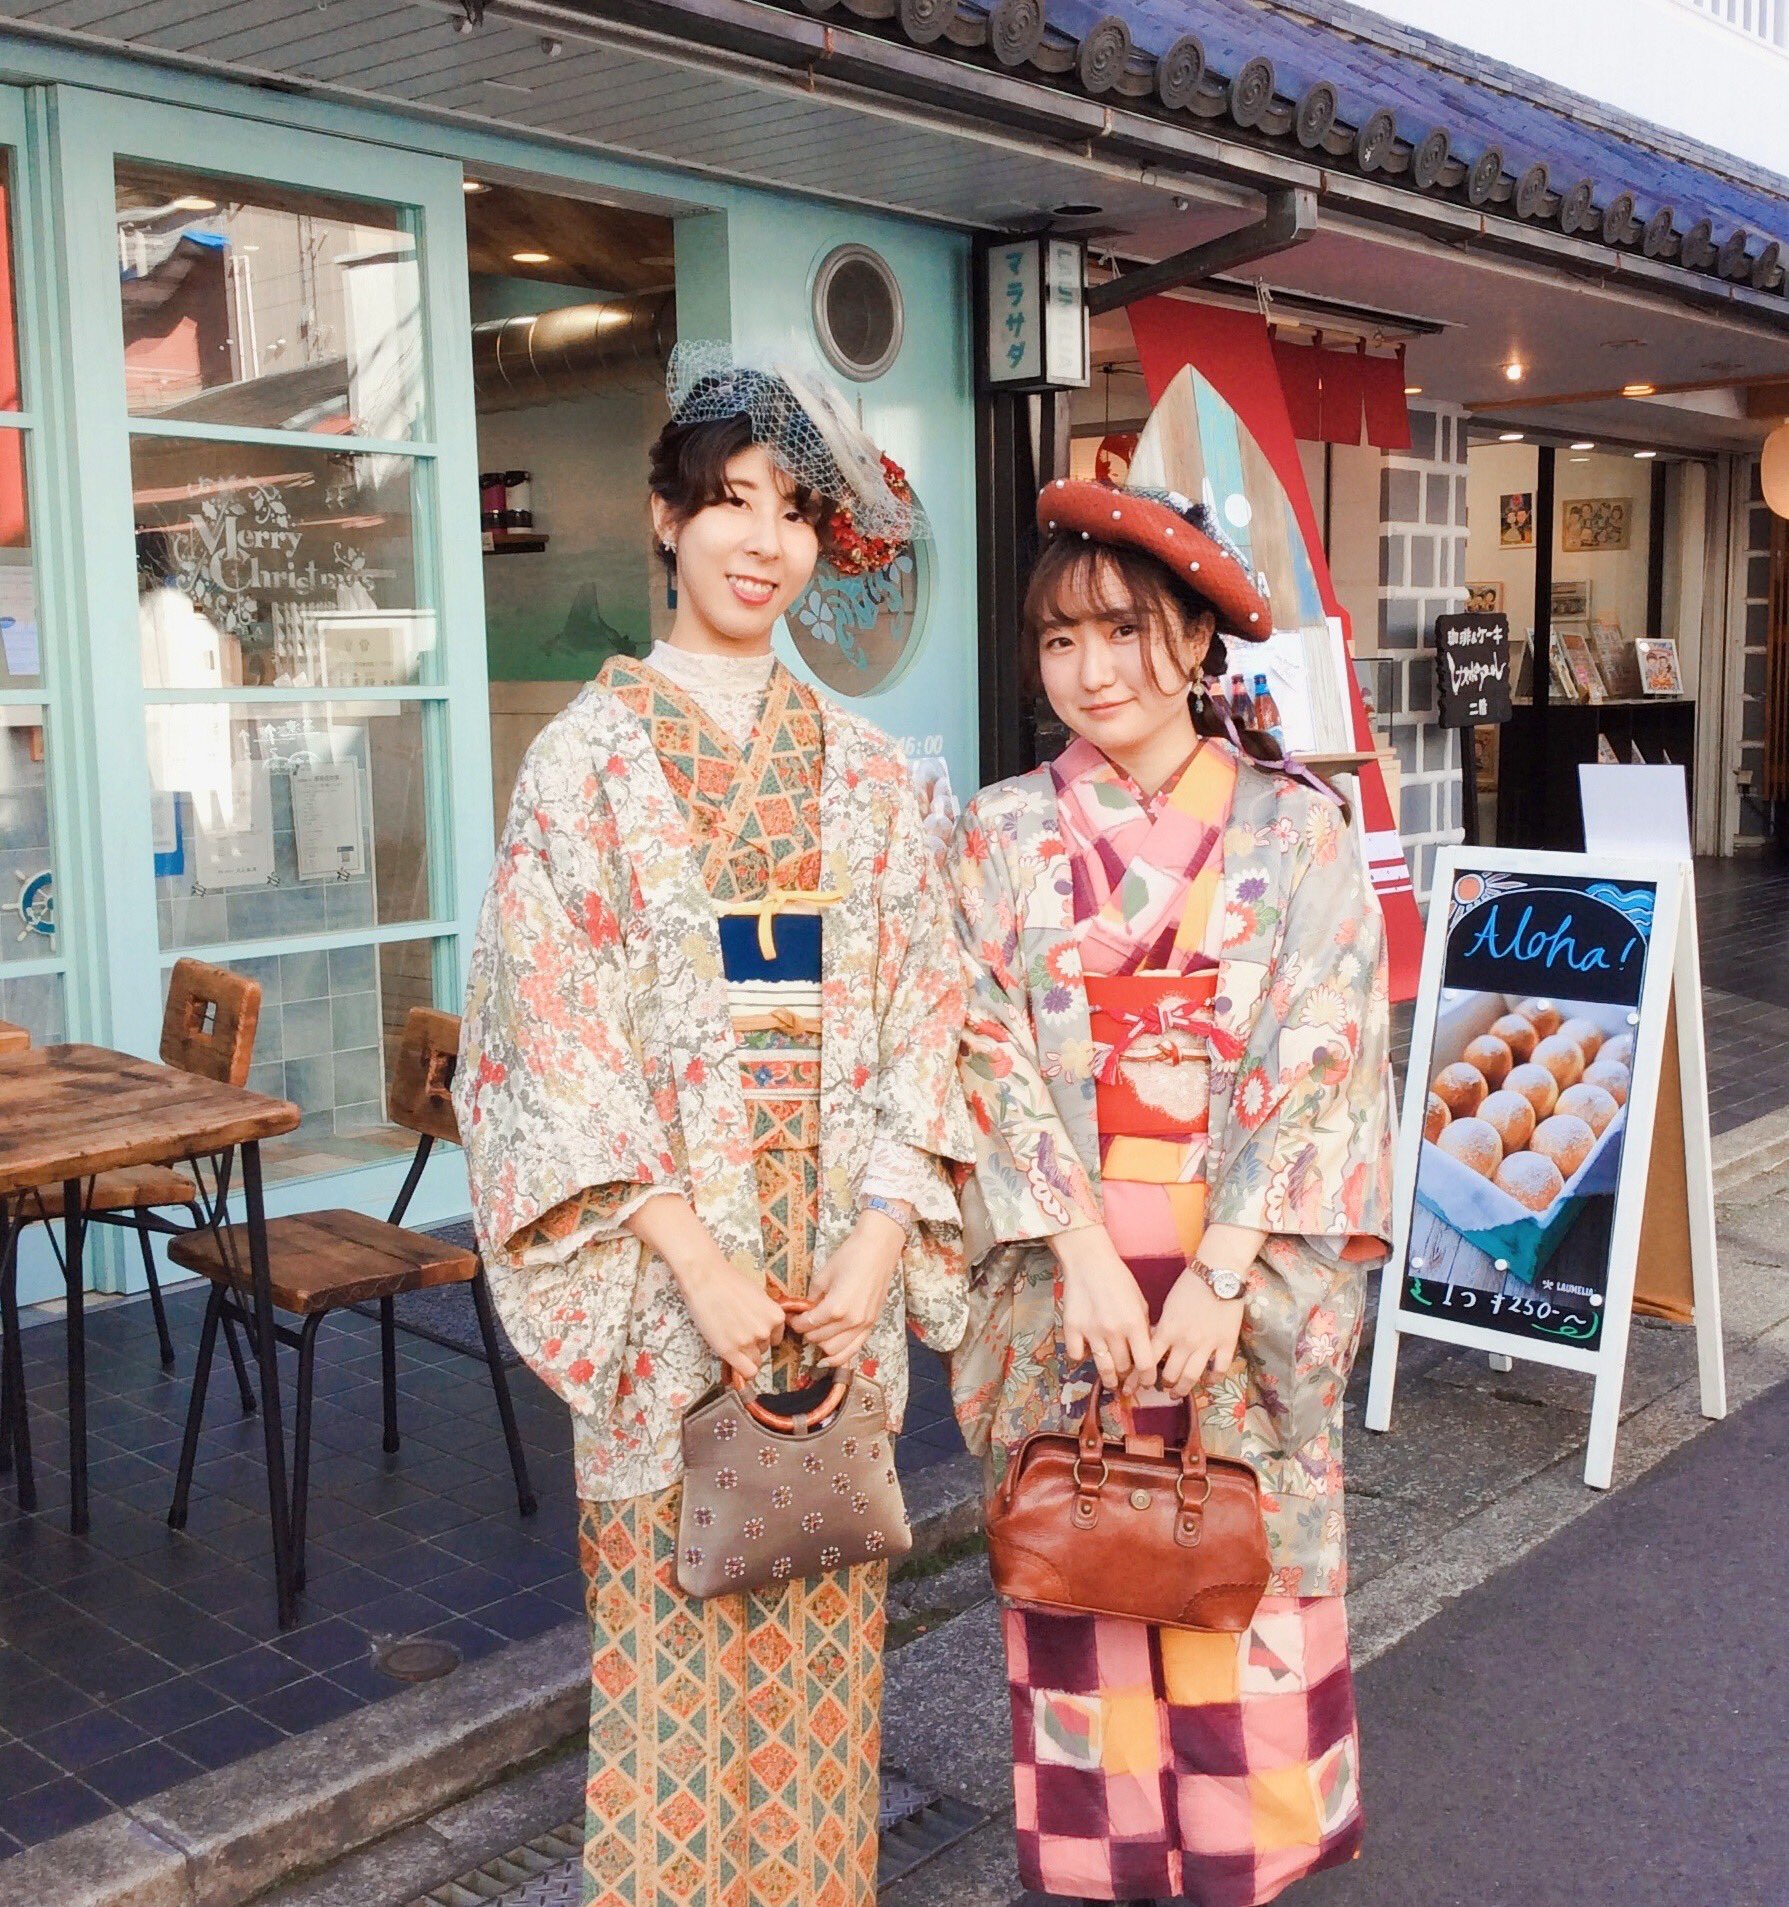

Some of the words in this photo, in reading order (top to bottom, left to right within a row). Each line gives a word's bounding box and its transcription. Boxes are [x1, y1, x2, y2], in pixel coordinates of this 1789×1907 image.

[1004, 250, 1026, 370] マラサダ
[188, 501, 302, 559] Merry
[901, 734, 944, 756] 6:00
